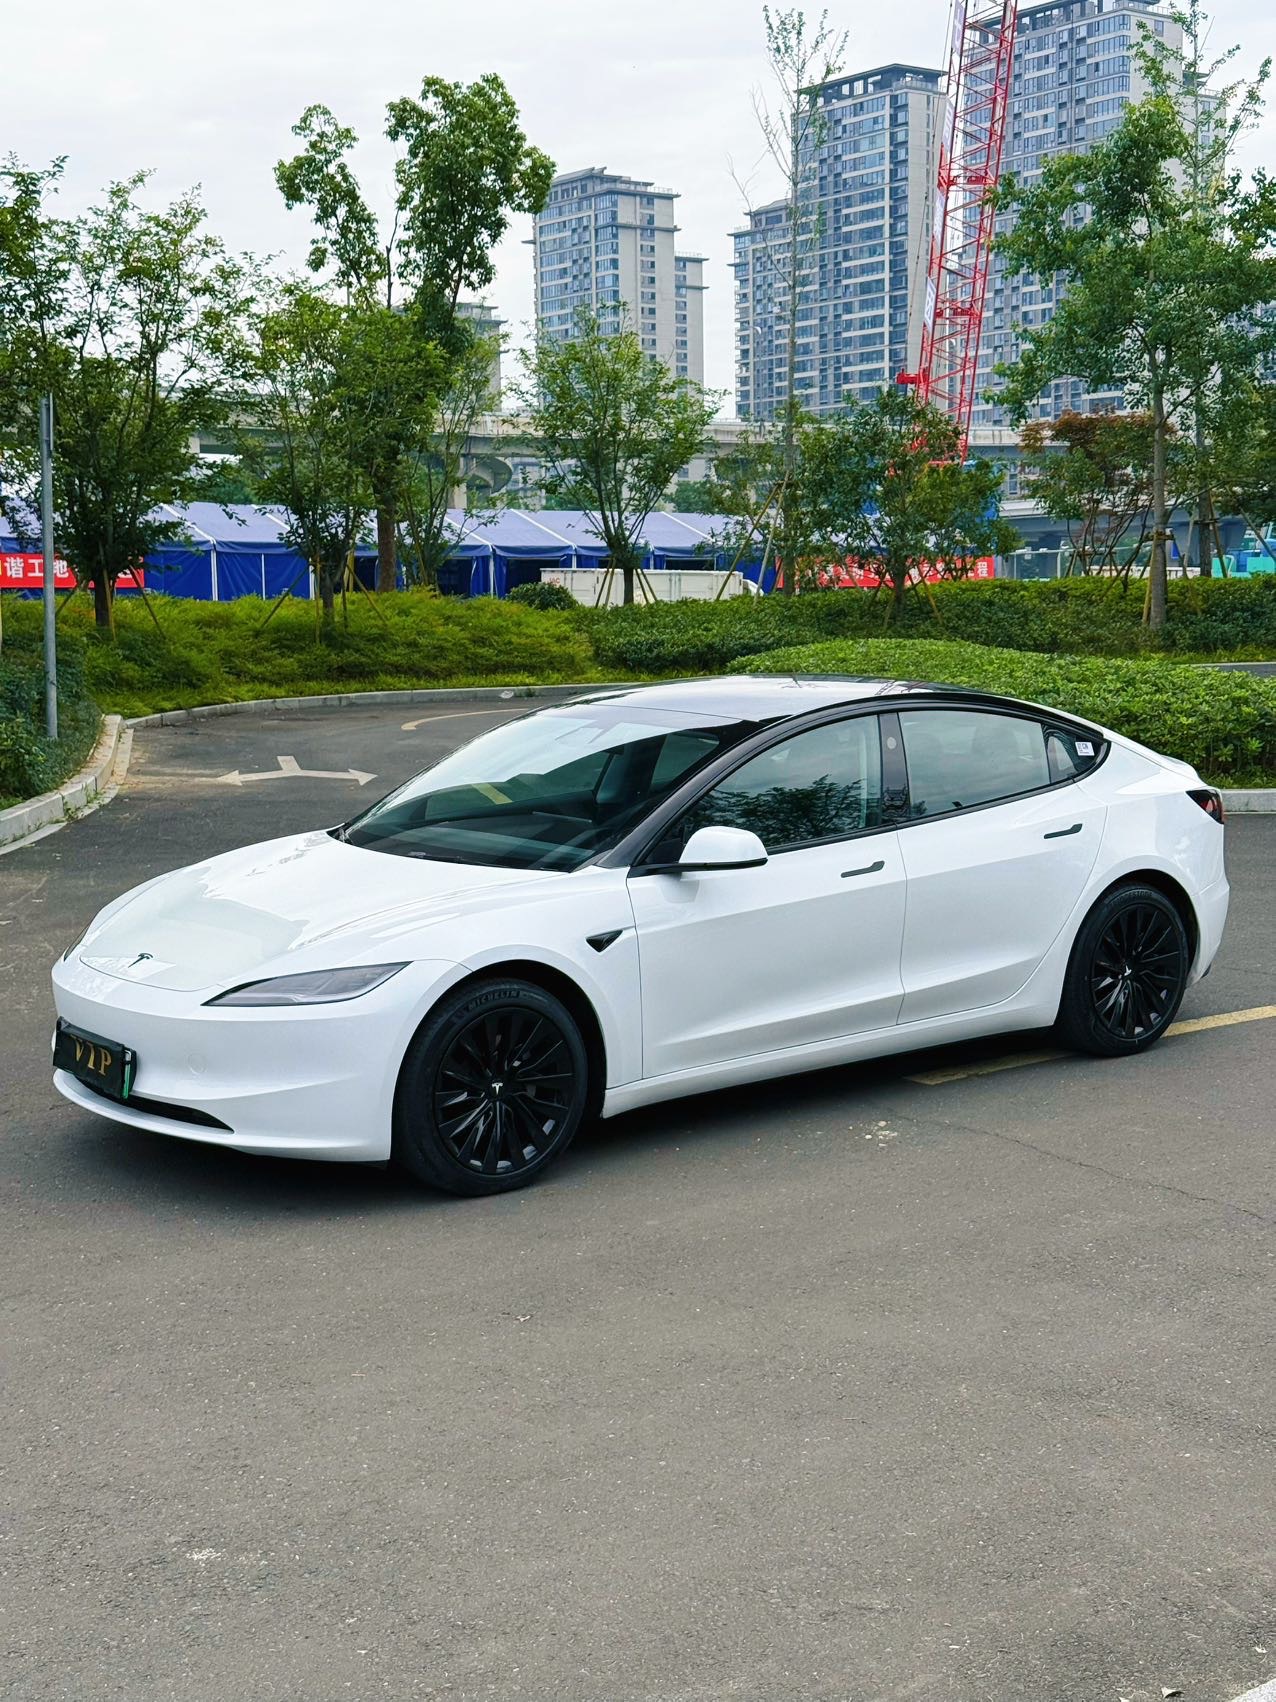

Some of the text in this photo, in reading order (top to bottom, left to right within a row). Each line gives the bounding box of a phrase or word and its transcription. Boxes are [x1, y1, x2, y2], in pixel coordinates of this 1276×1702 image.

[0, 556, 69, 578] 谐工地
[70, 1034, 112, 1076] VIP
